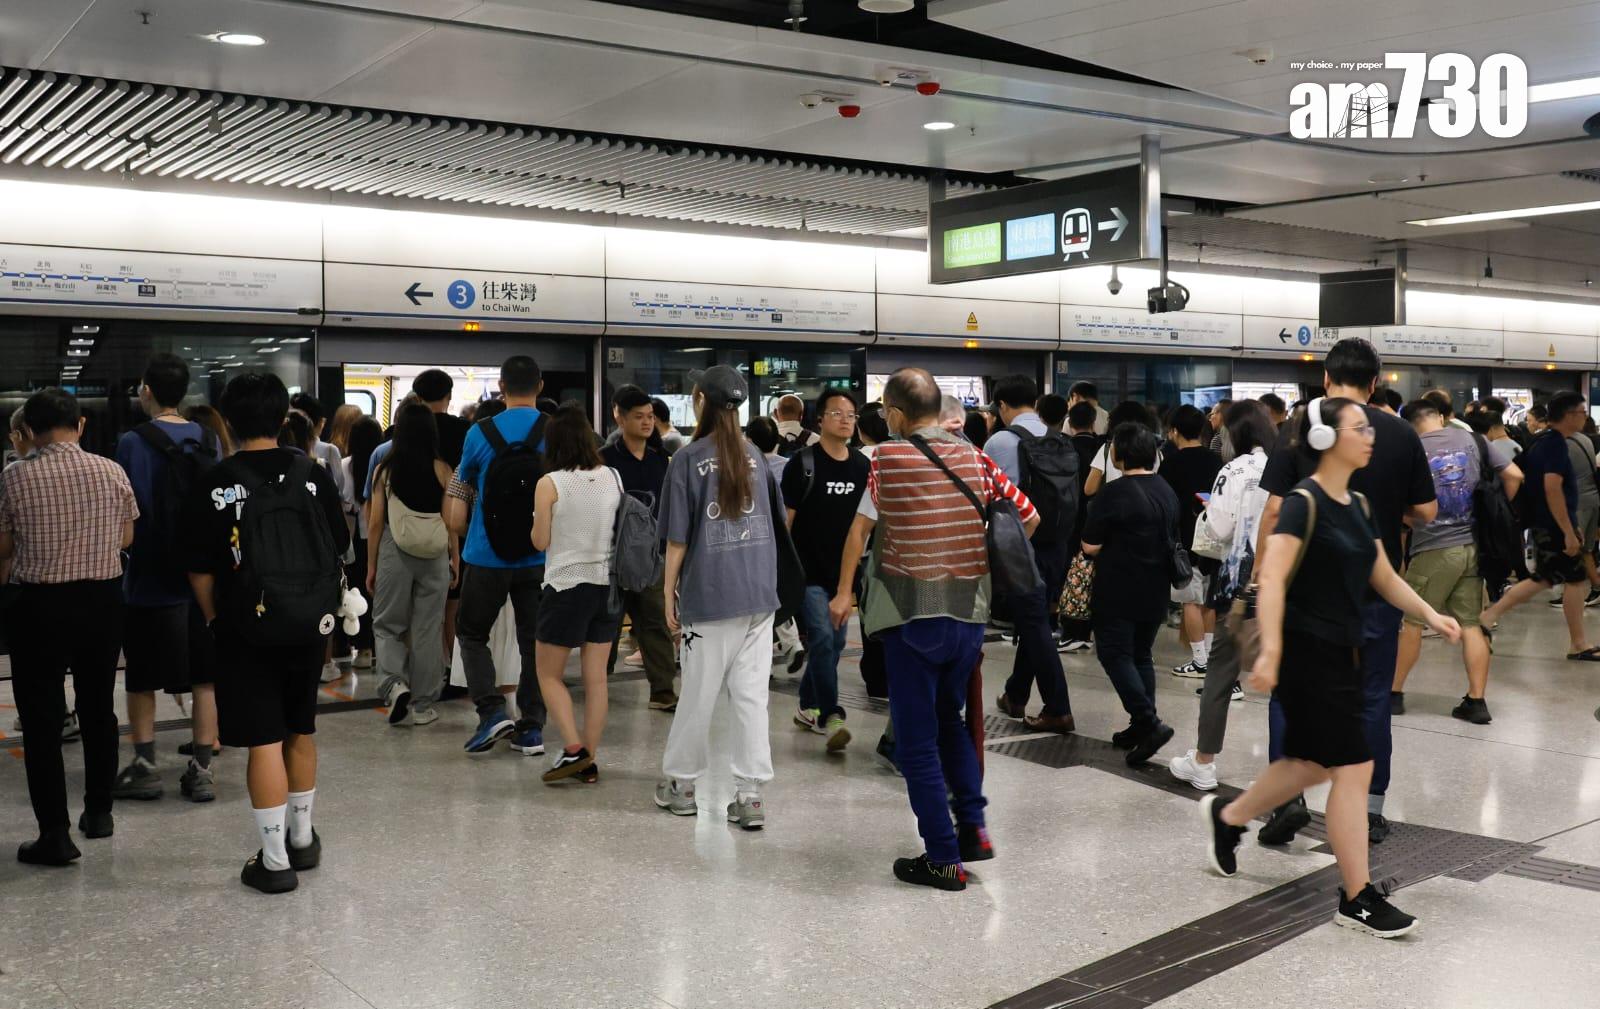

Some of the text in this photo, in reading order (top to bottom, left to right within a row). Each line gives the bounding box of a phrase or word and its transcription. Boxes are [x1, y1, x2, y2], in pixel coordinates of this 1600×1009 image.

[456, 284, 468, 305] 3
[482, 281, 537, 302] 往柴灣
[482, 303, 530, 313] to Chai Wan
[1300, 328, 1308, 343] 3
[826, 481, 856, 495] TOP
